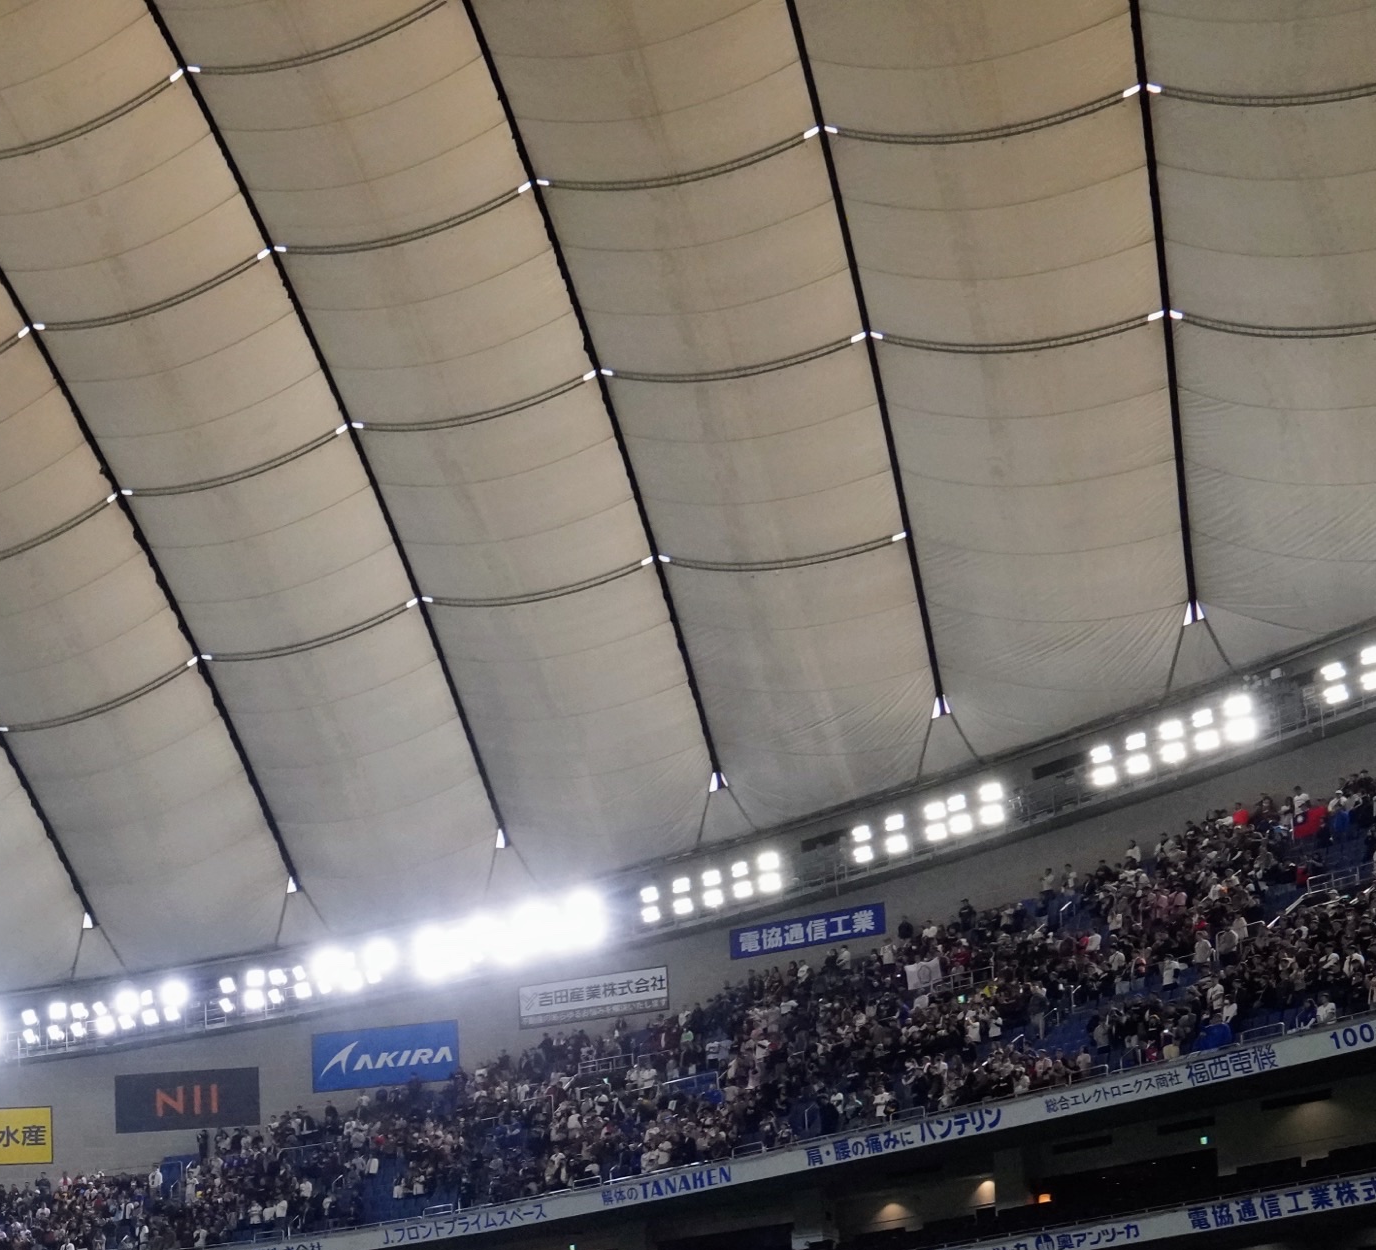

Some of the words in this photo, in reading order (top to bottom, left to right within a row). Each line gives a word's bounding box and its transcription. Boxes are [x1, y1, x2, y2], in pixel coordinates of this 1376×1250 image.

[738, 909, 875, 952] 電協通信工業
[538, 974, 666, 1007] 吉田産業株式会社
[1330, 1023, 1375, 1050] 100
[352, 1046, 454, 1072] AKIRA
[1186, 1044, 1279, 1087] 福西電機
